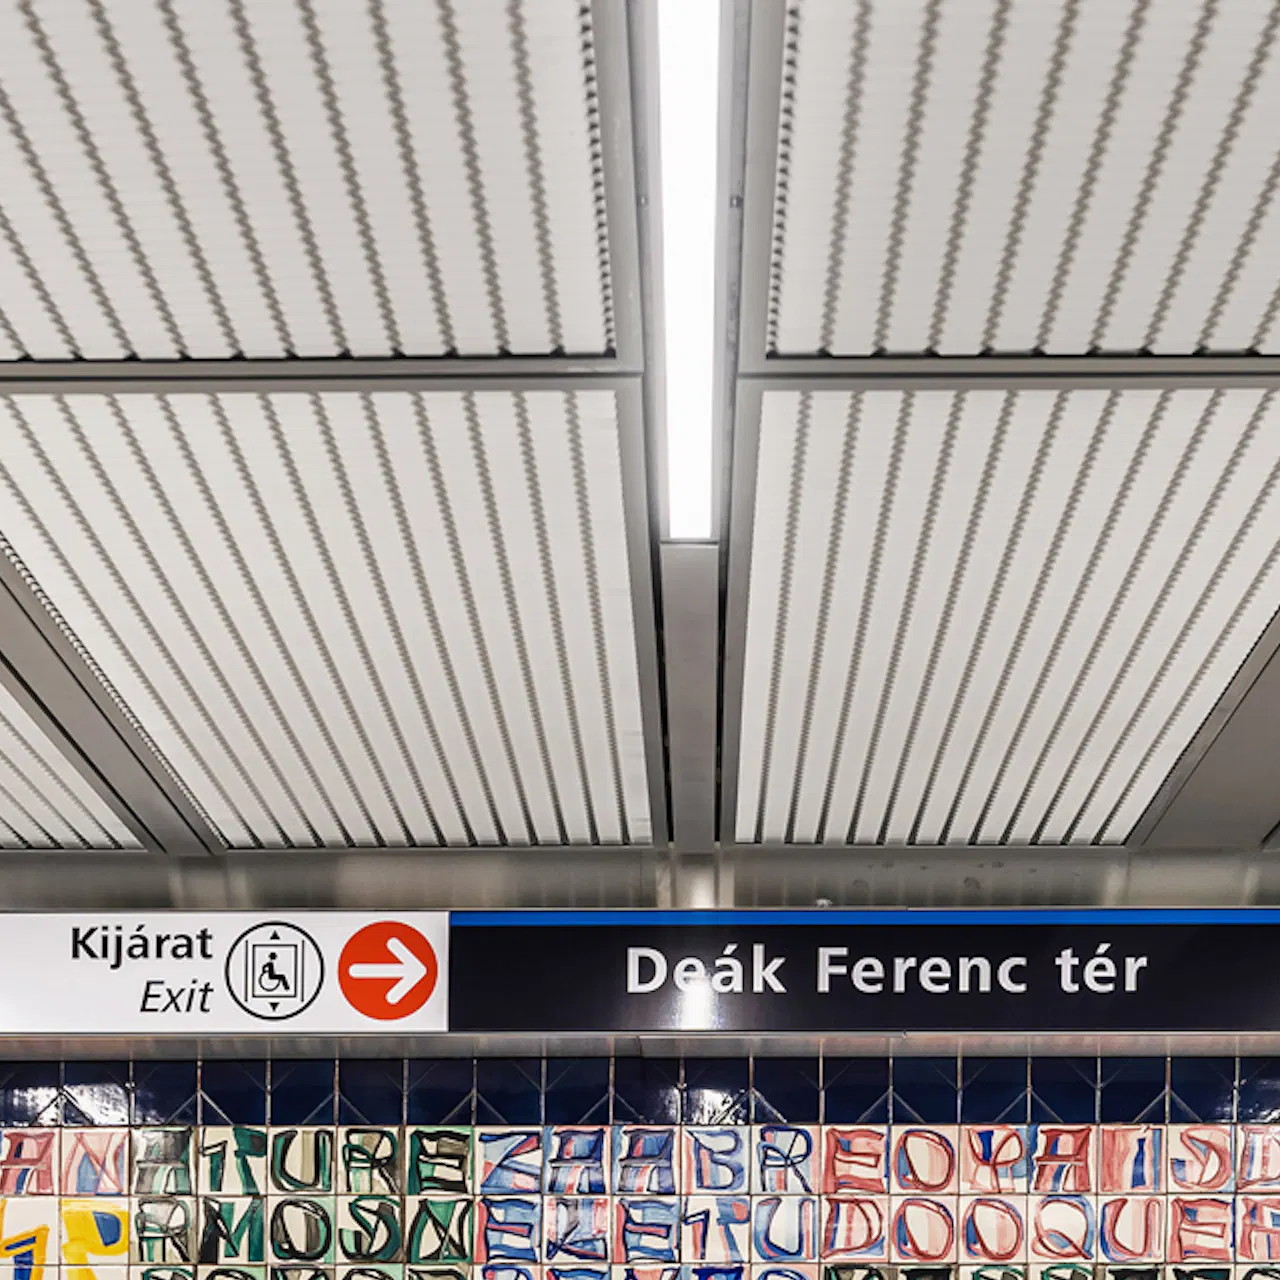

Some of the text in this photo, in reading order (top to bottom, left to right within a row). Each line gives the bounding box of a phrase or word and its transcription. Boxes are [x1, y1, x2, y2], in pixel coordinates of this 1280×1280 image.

[72, 925, 213, 963] Kijárat
[627, 943, 1148, 993] Deák Ferenc tér
[139, 979, 214, 1013] Exit
